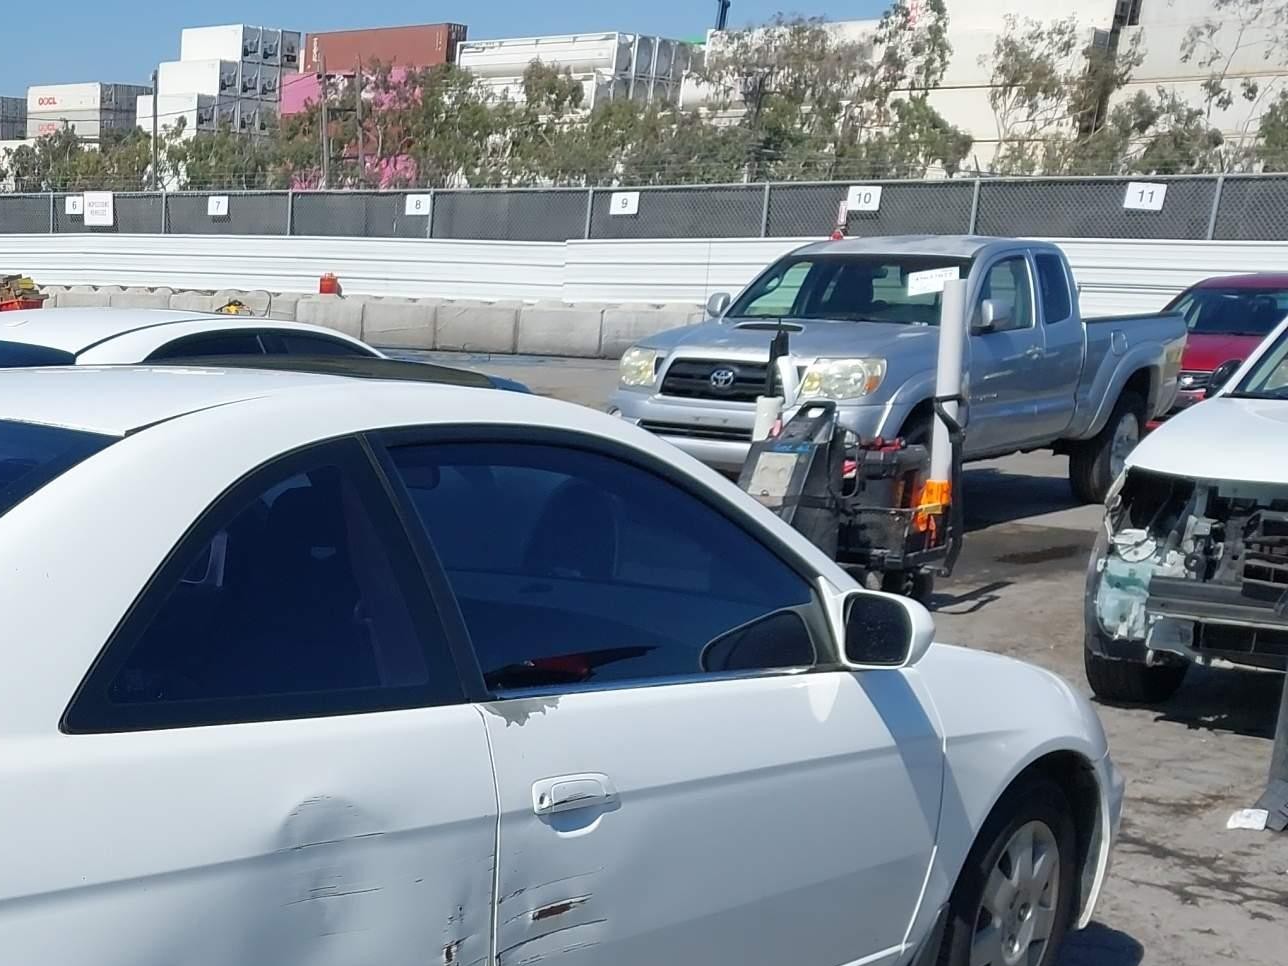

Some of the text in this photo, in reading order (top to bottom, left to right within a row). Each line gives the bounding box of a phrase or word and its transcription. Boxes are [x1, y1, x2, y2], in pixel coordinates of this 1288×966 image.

[39, 97, 57, 106] OOCL
[856, 192, 872, 205] 10
[1137, 190, 1156, 204] 11
[72, 200, 77, 210] 6
[215, 200, 221, 211] 7
[415, 199, 421, 210] 8
[621, 198, 628, 209] 9
